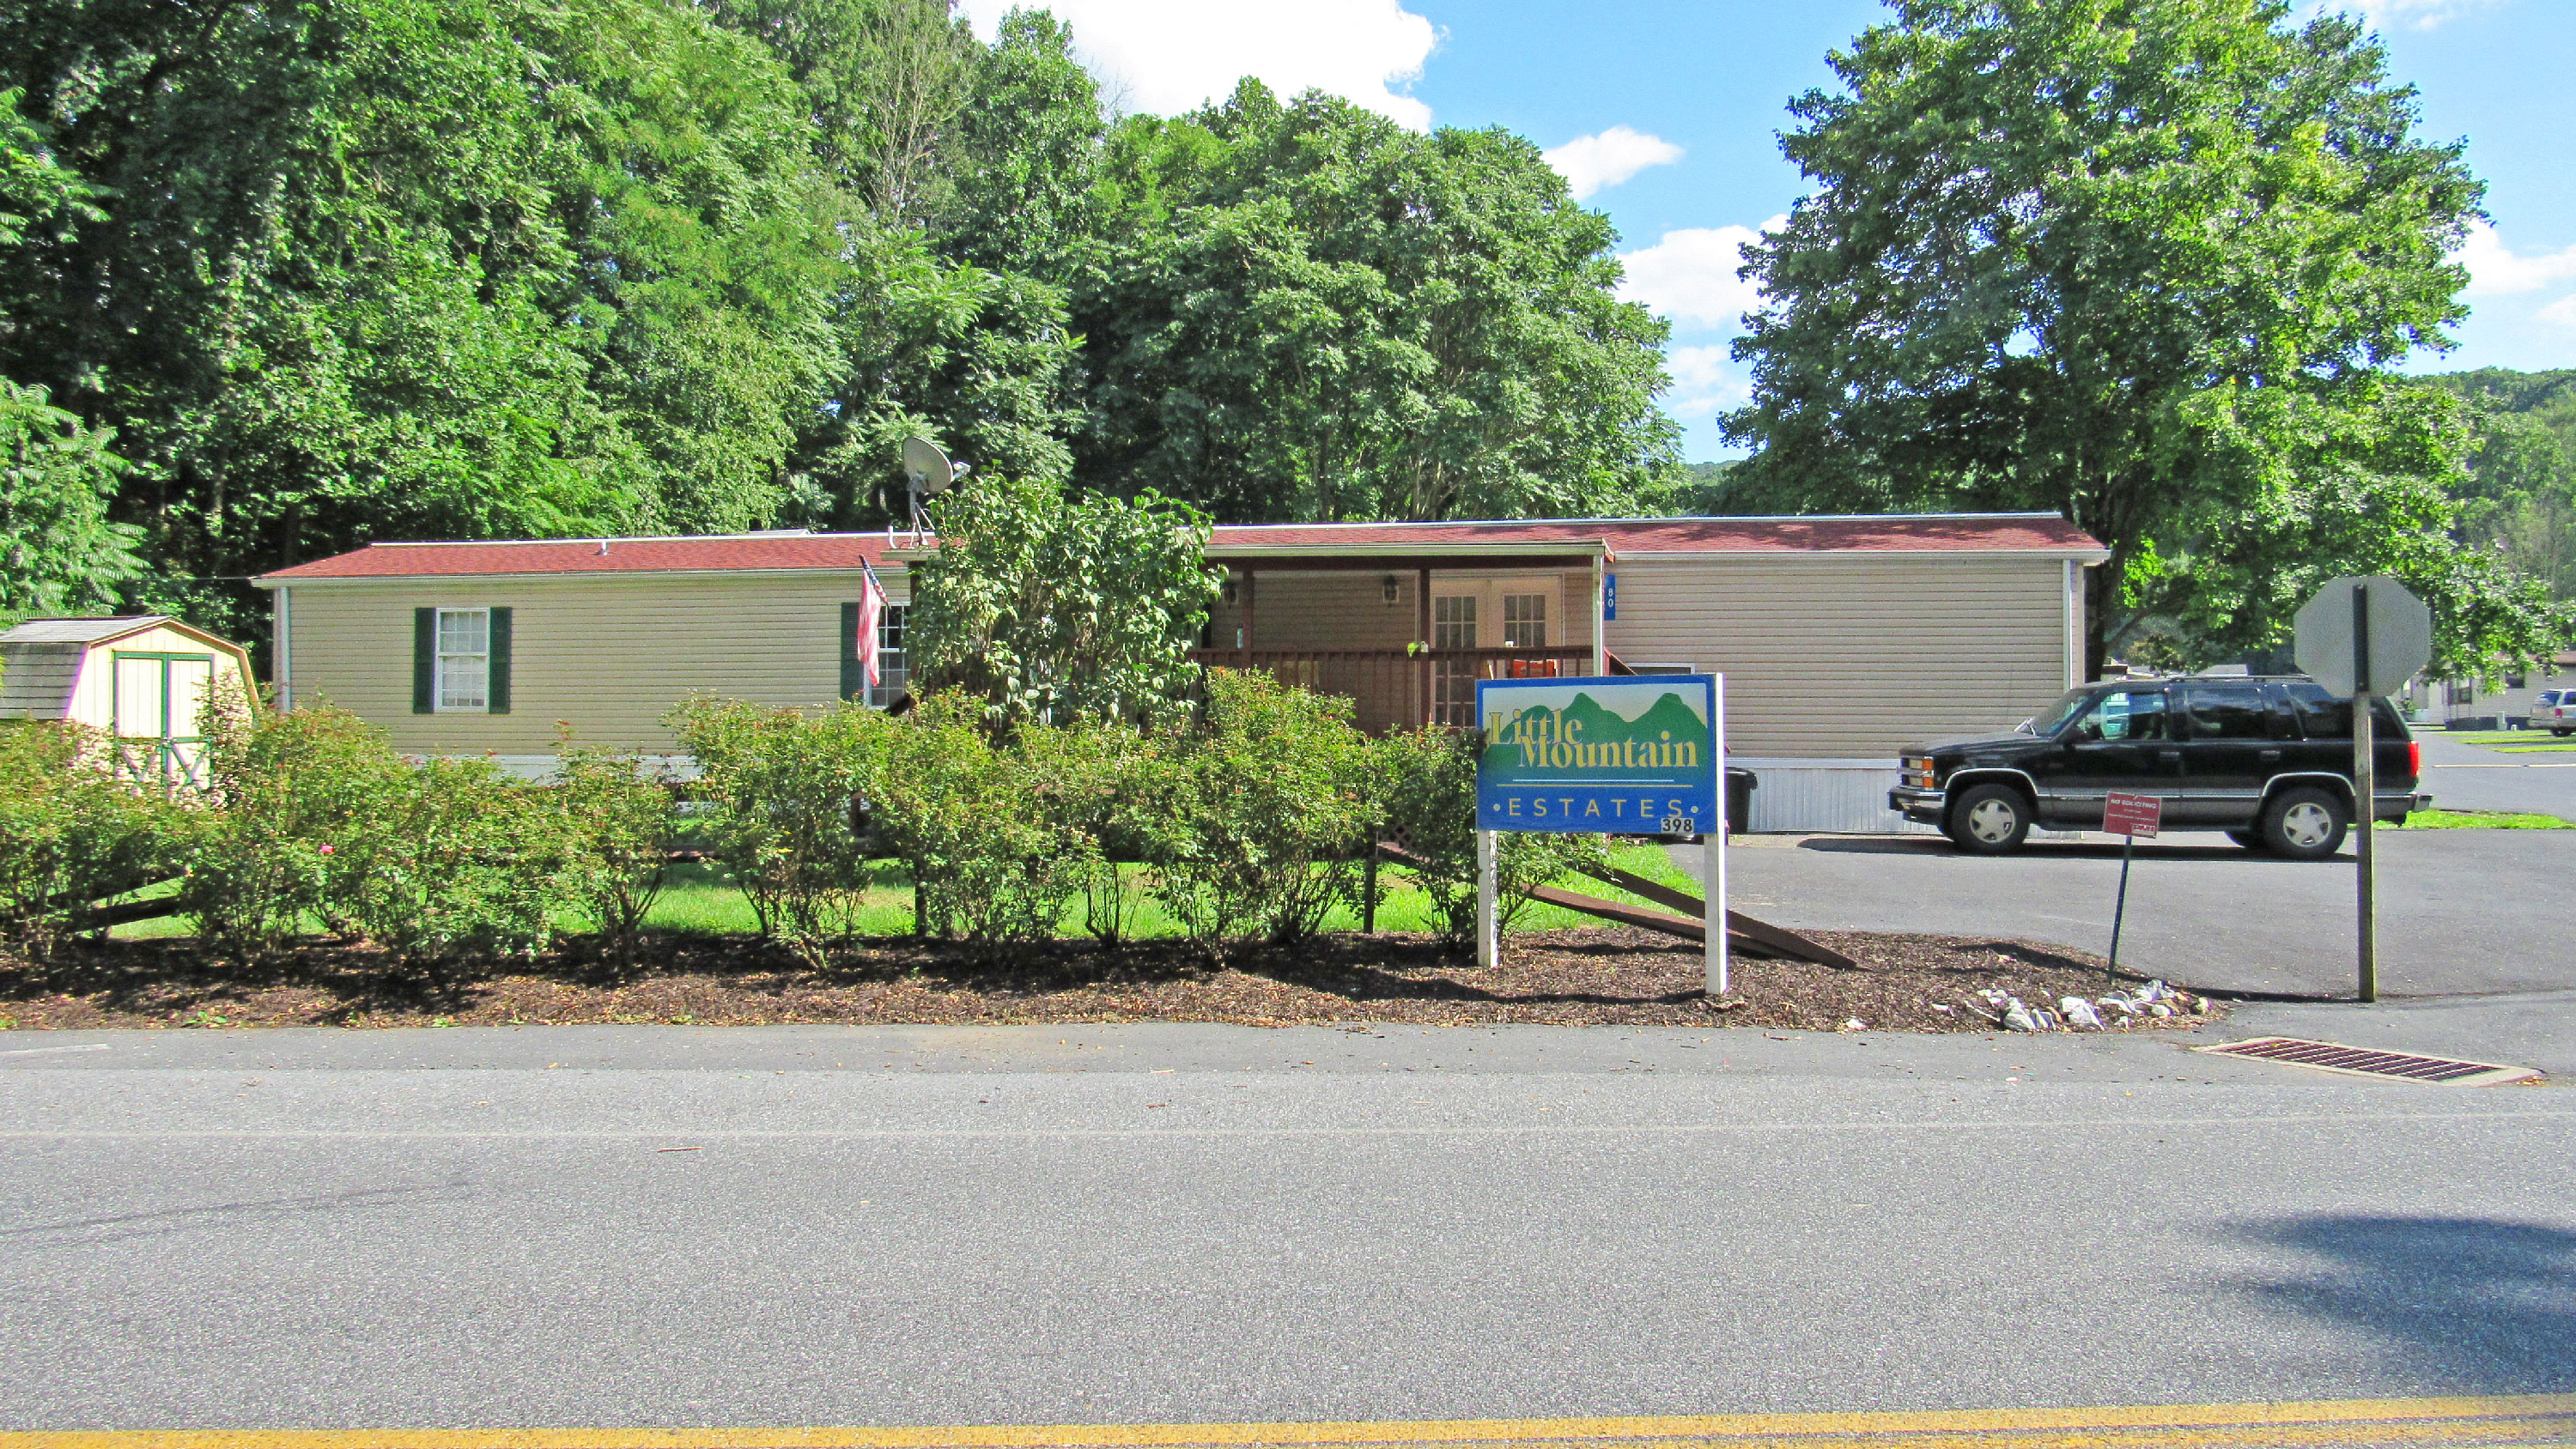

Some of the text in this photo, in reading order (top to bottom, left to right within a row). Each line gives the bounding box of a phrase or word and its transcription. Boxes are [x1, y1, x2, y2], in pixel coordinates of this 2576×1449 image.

[1607, 588, 1613, 608] 80
[1489, 708, 1583, 745] Little
[1518, 731, 1699, 767] Mountain
[1509, 797, 1683, 817] ESTATES
[1662, 818, 1693, 832] 398
